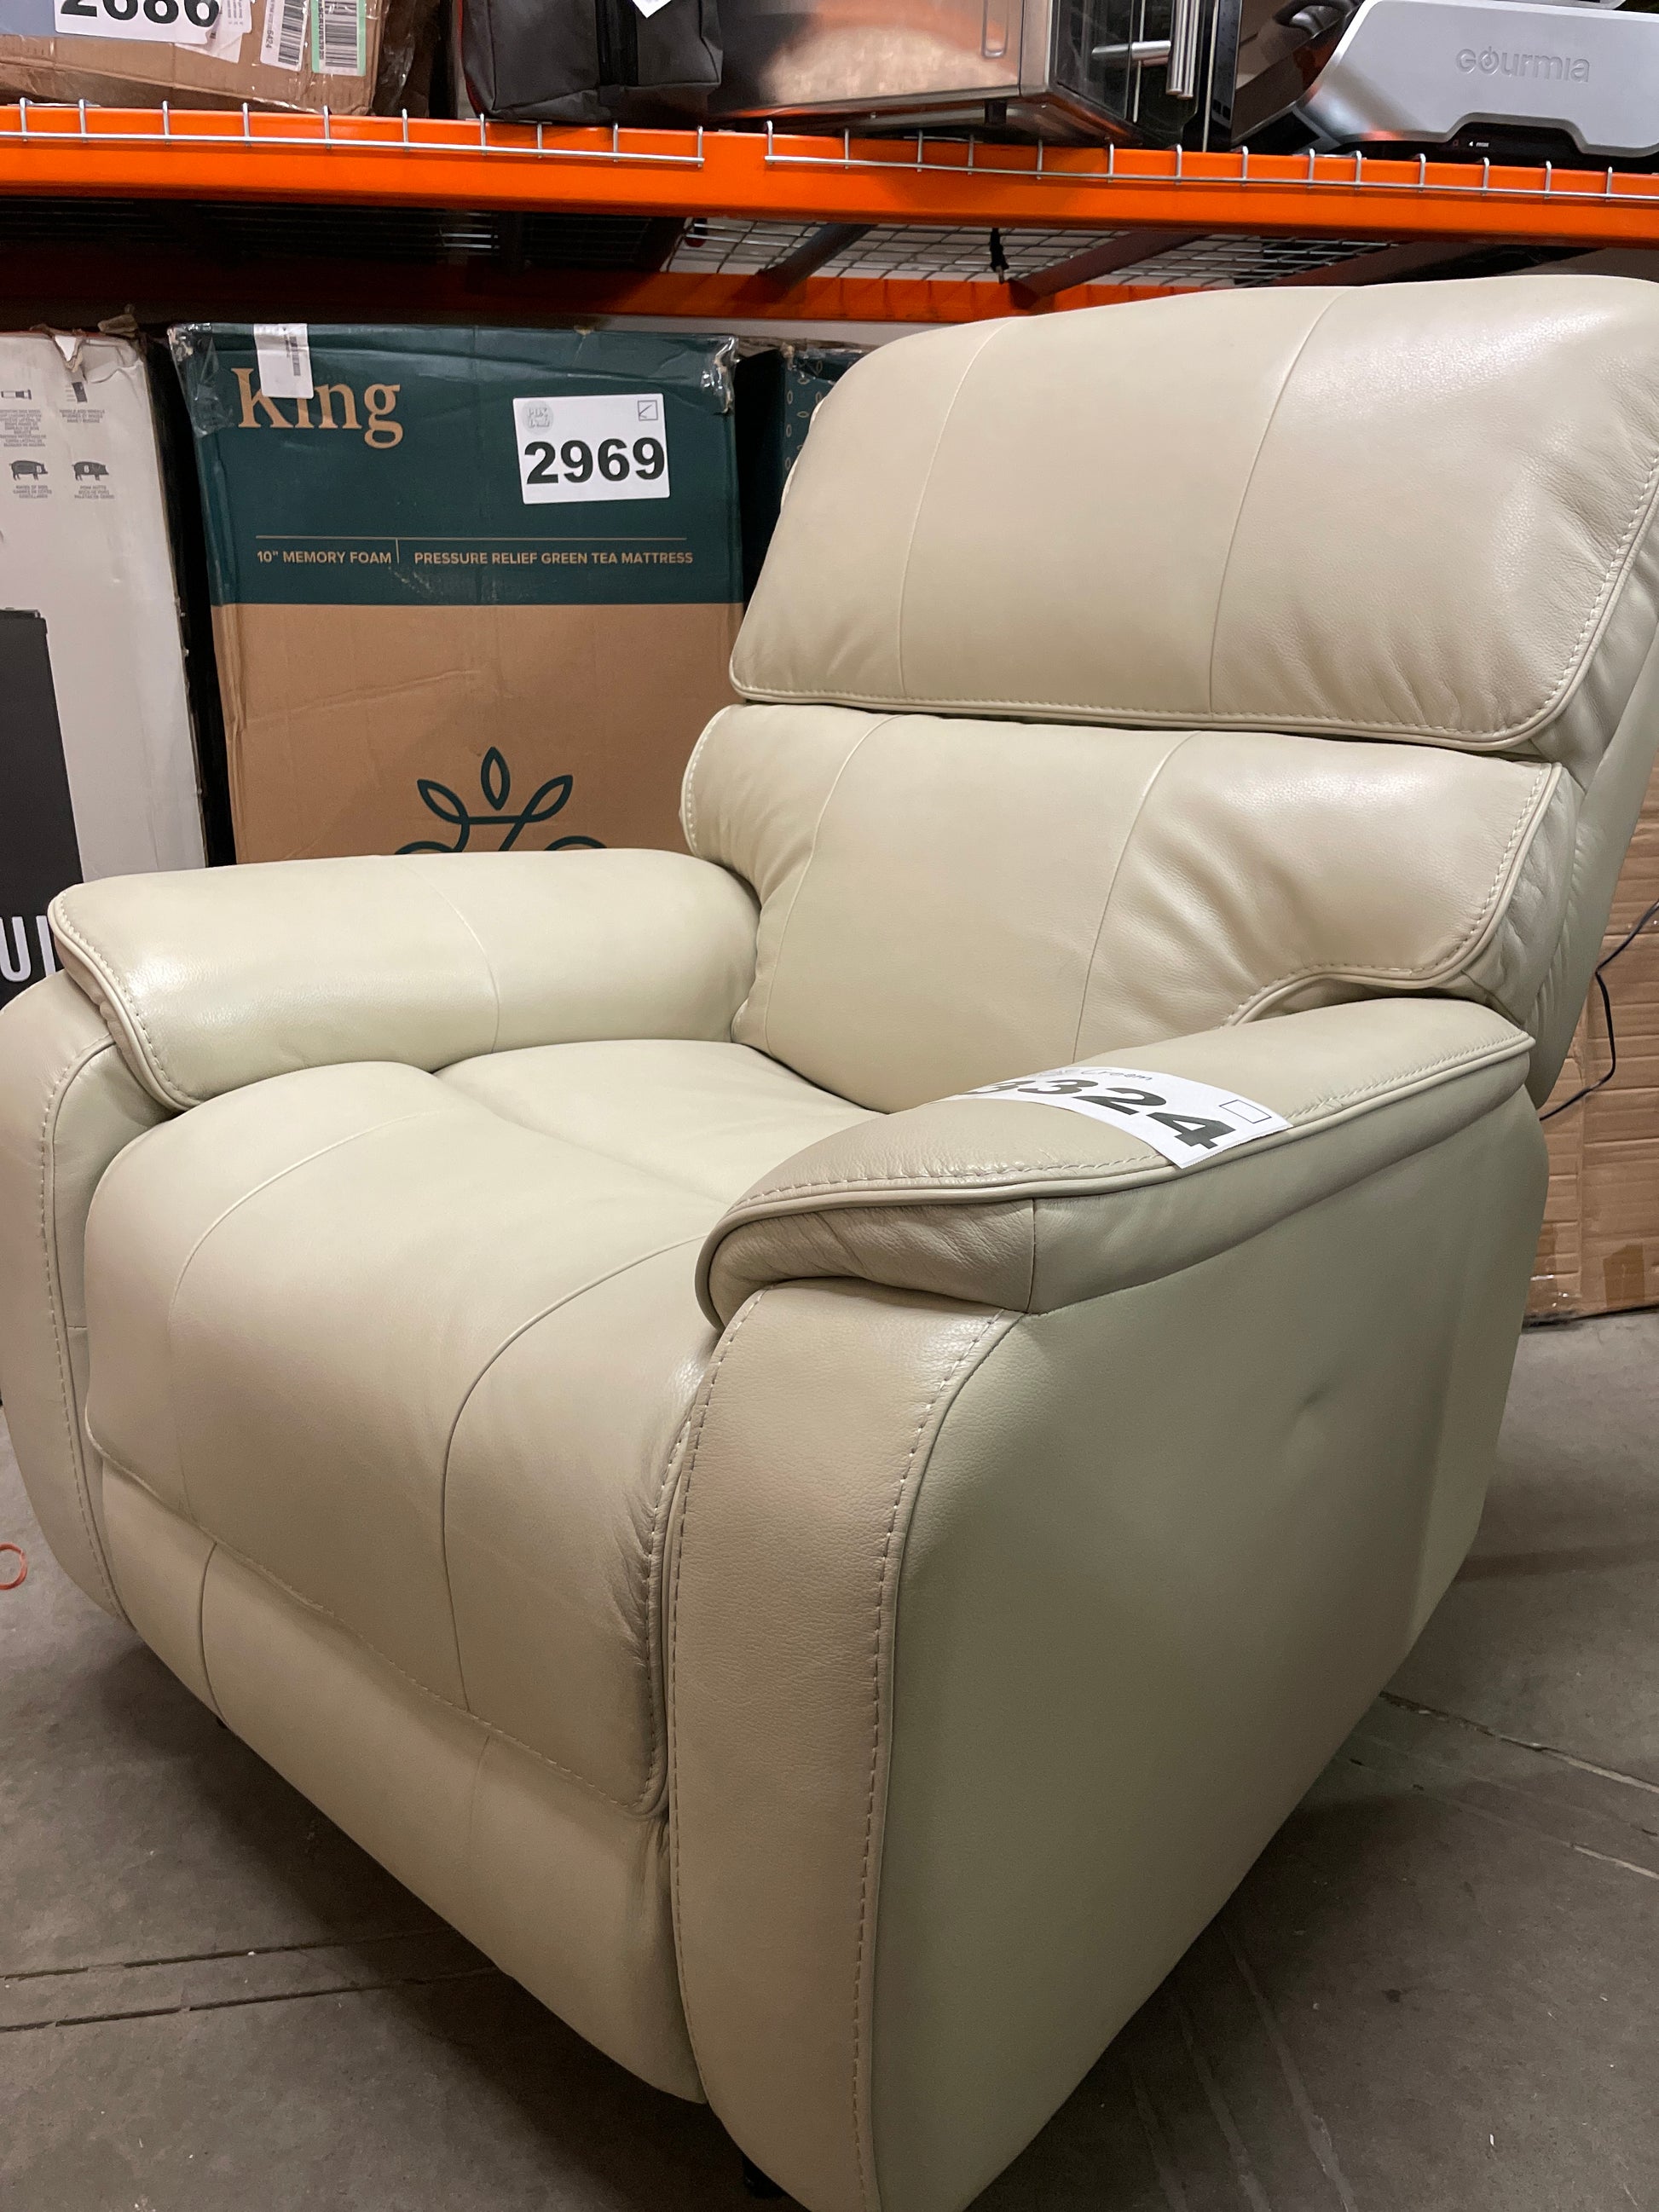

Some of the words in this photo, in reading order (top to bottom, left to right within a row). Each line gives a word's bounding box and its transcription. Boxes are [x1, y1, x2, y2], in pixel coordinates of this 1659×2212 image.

[1456, 46, 1590, 83] Gourmia
[524, 437, 665, 484] 2969
[257, 551, 279, 563] 10"
[283, 552, 346, 563] MEMORY
[350, 552, 391, 563] FOAM
[414, 552, 488, 564] PRESSURE
[492, 552, 537, 564] RELIEF
[541, 552, 587, 564] GREEN
[591, 552, 618, 564] TEA
[621, 552, 693, 564] MATTRESS
